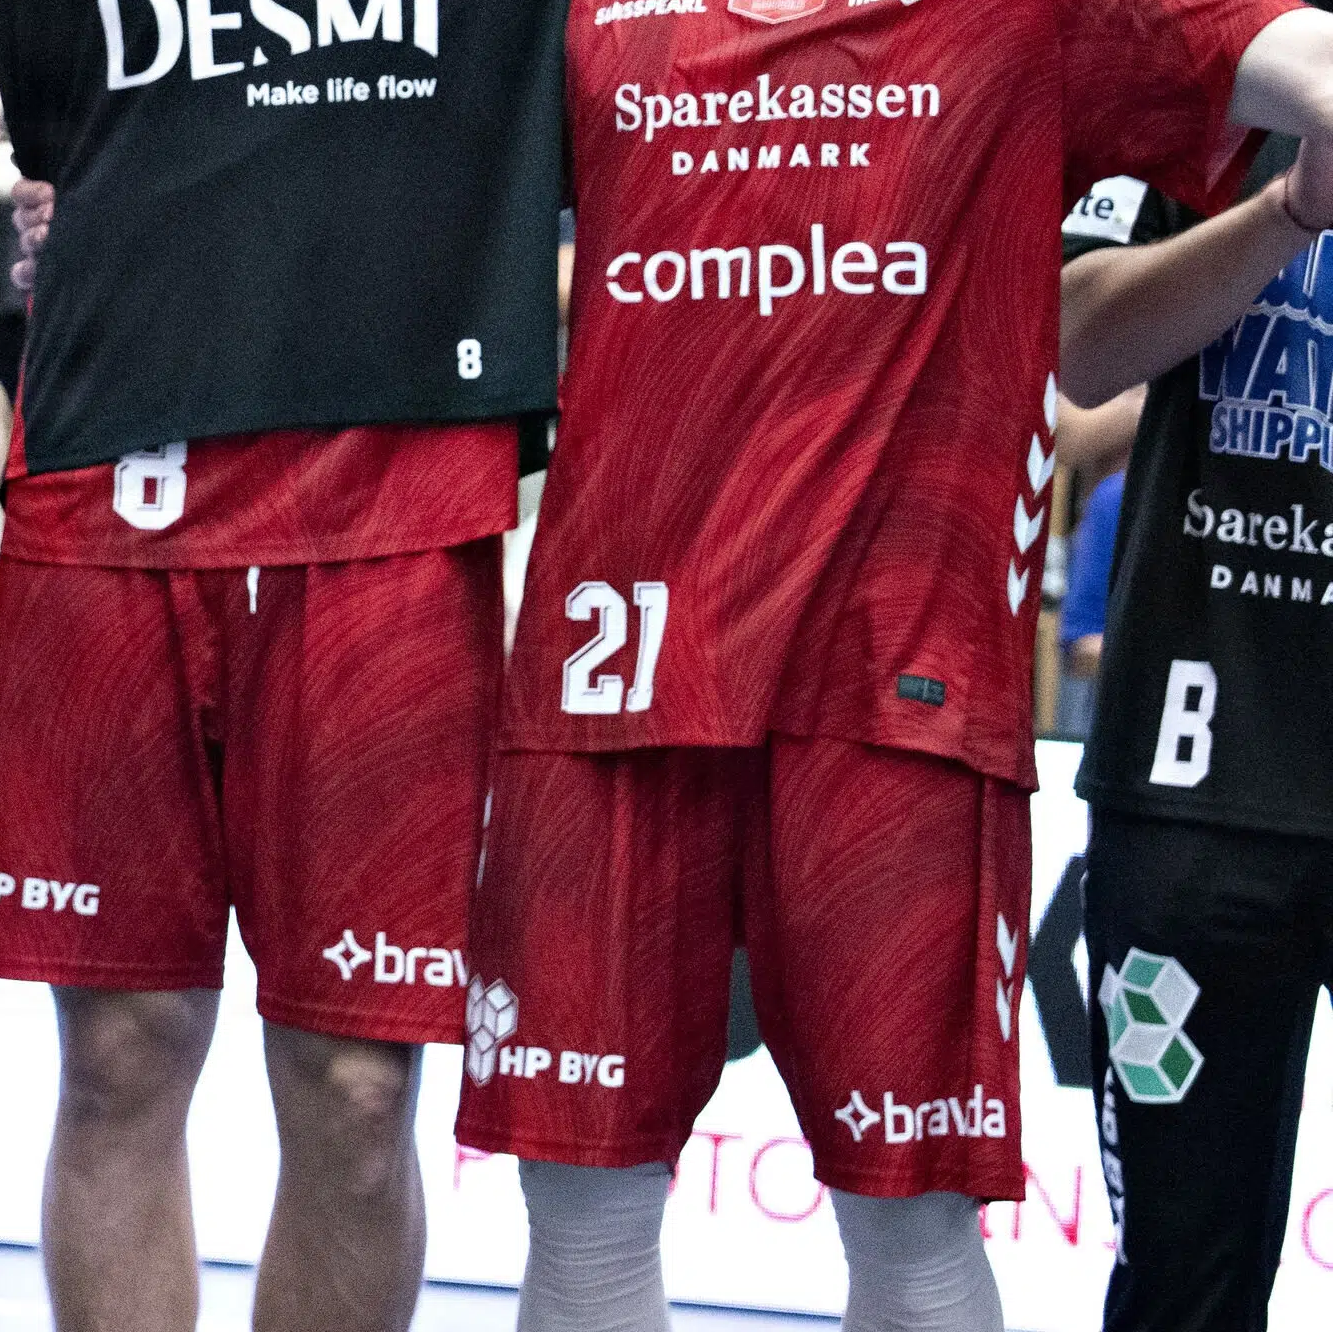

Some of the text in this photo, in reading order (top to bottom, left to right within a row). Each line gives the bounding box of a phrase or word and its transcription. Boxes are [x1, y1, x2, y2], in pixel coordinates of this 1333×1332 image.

[246, 74, 438, 108] Make life flow
[614, 72, 940, 142] Sparekassen
[671, 142, 871, 176] DANMARK
[605, 223, 928, 317] complea
[456, 338, 483, 380] 8
[561, 581, 669, 715] 21
[1149, 659, 1219, 789] B
[21, 876, 100, 917] BYG
[499, 1045, 626, 1089] HP BYG
[883, 1083, 1007, 1144] bravda
